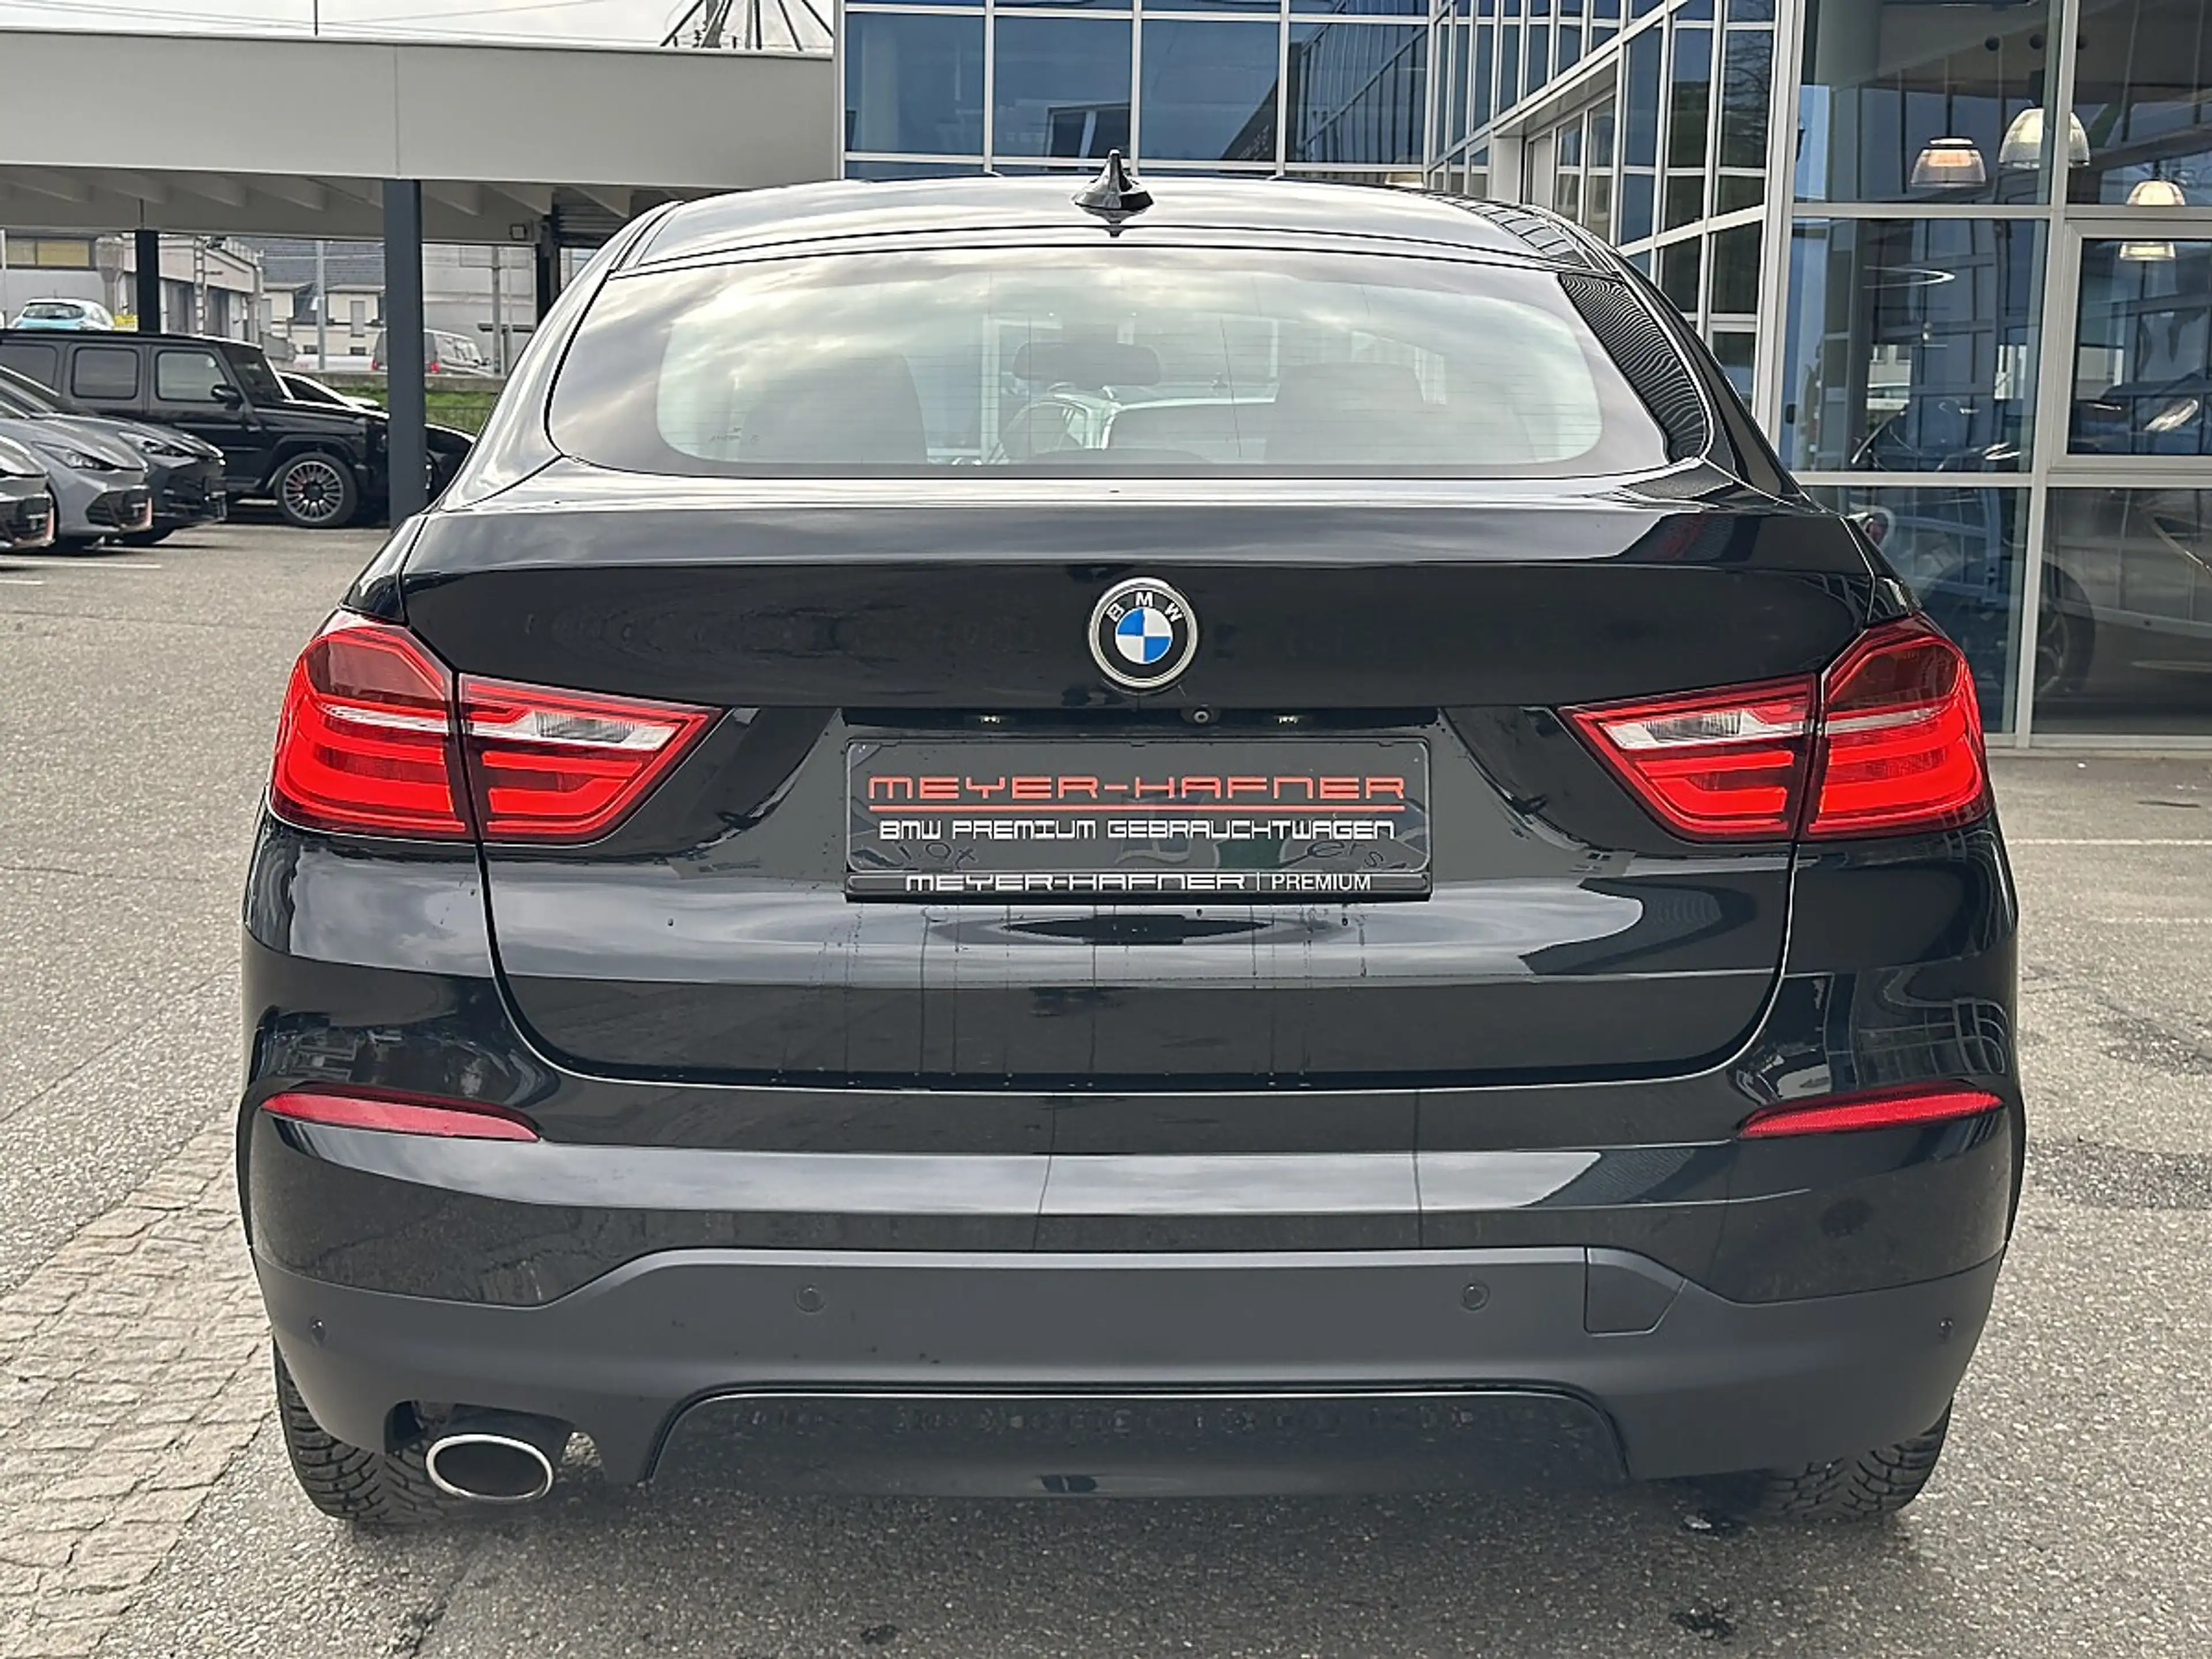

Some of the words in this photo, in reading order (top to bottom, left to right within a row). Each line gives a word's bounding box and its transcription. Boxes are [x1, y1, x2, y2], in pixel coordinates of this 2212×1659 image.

[1106, 592, 1183, 622] BMW
[869, 777, 1404, 799] MEYER-HAFNER
[880, 820, 942, 840] BMW
[952, 820, 1096, 840] PREMIUM
[1107, 820, 1395, 840] GEBRAUCHTWAGEN
[906, 874, 1245, 891] MEYER-HAFNER
[1271, 874, 1371, 891] PREMIUM
